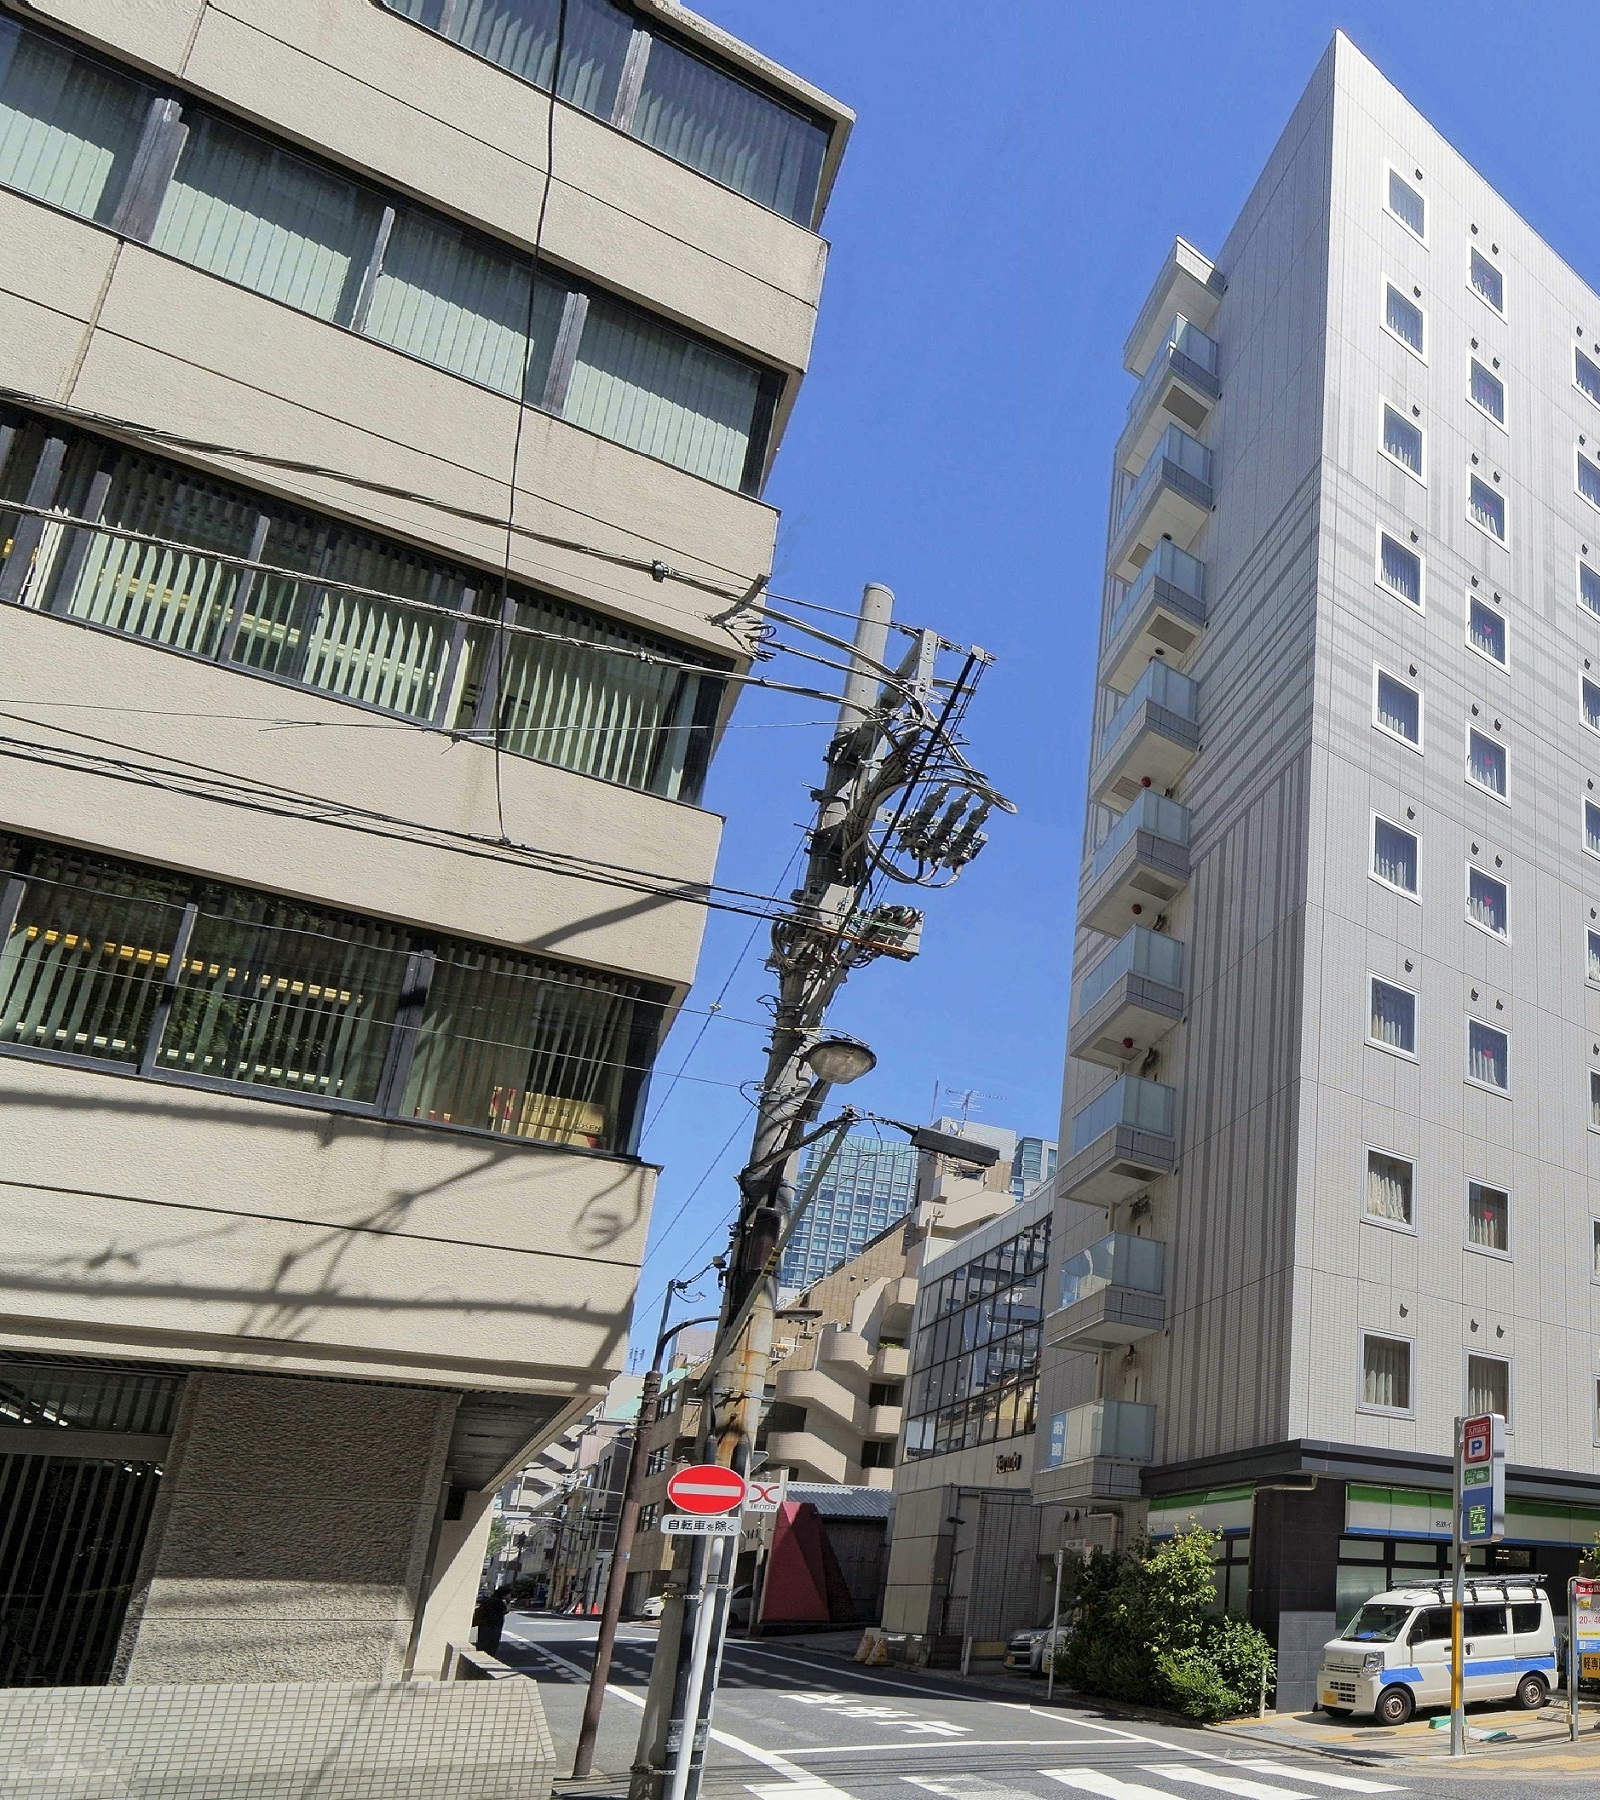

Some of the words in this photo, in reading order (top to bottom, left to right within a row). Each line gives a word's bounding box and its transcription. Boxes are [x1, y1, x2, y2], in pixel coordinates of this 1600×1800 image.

[1471, 1440, 1483, 1456] P
[668, 1520, 734, 1532] 自転車を除く
